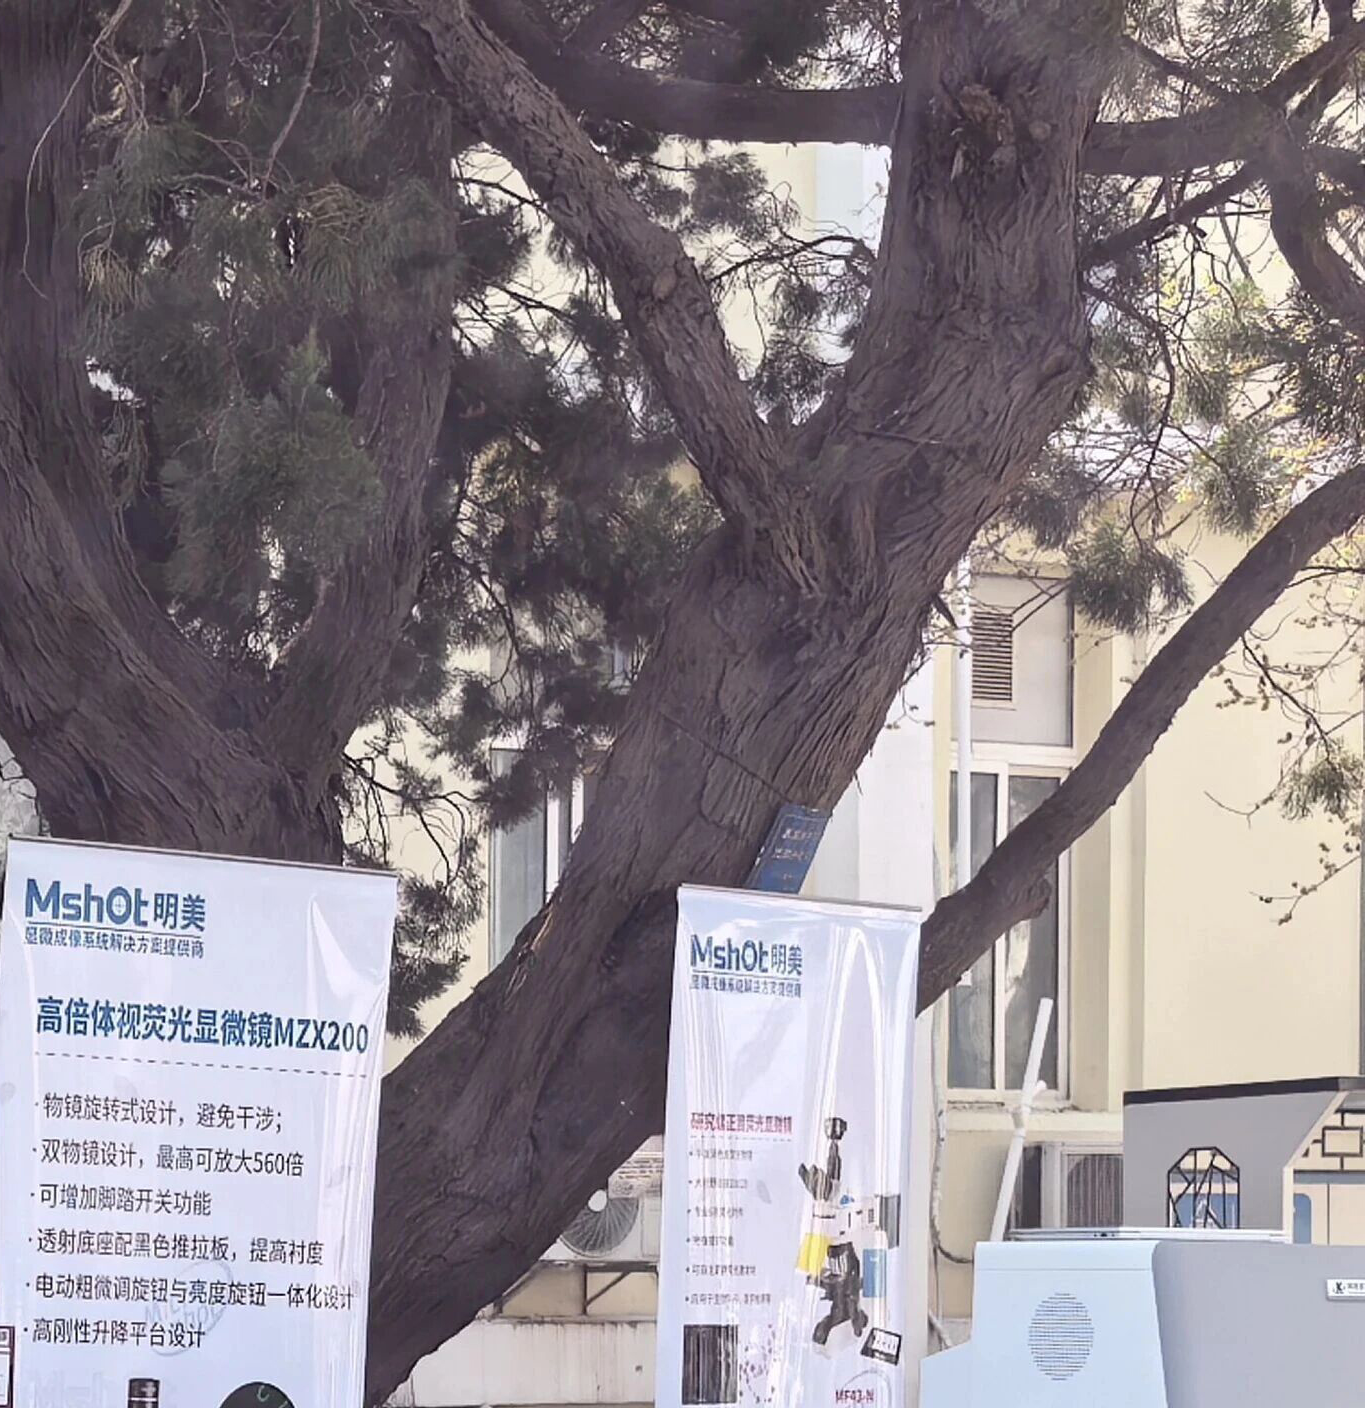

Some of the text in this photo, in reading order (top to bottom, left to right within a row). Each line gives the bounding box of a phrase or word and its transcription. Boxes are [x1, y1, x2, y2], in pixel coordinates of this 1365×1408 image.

[153, 892, 206, 932] 明美
[36, 995, 370, 1054] 高倍体视荧光显微镜MZX200
[39, 1183, 212, 1217] 可增加脚踏开关功能
[32, 1317, 207, 1349] 高刚性升降平台设计
